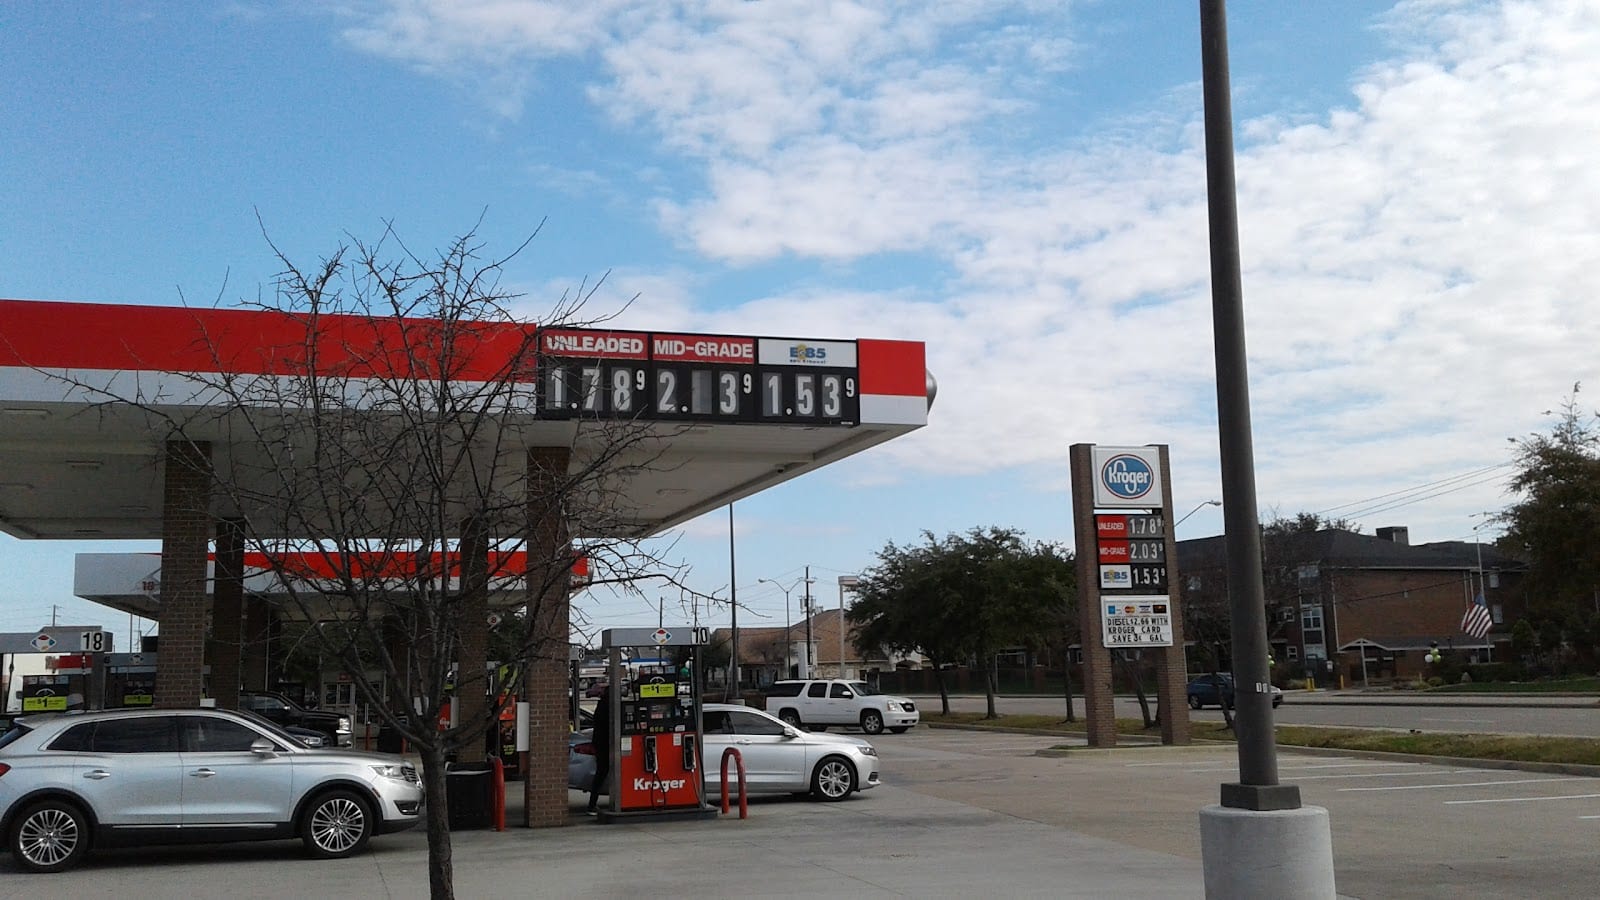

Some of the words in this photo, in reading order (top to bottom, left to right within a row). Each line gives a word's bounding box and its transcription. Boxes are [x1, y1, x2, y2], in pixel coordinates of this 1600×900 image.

[546, 335, 644, 354] UNLEADED
[653, 339, 754, 358] MID-GRADE
[1108, 459, 1149, 494] Kroger
[1097, 521, 1125, 531] UNLEADED
[1099, 546, 1127, 556] MID-GRADE
[1107, 625, 1136, 634] KROGER
[1141, 625, 1161, 634] CARD
[1151, 617, 1169, 626] WITH
[82, 632, 104, 651] 18
[693, 628, 709, 644] 10
[1112, 634, 1132, 643] SAVE
[1149, 634, 1165, 642] GAL
[633, 777, 686, 793] Kroger
